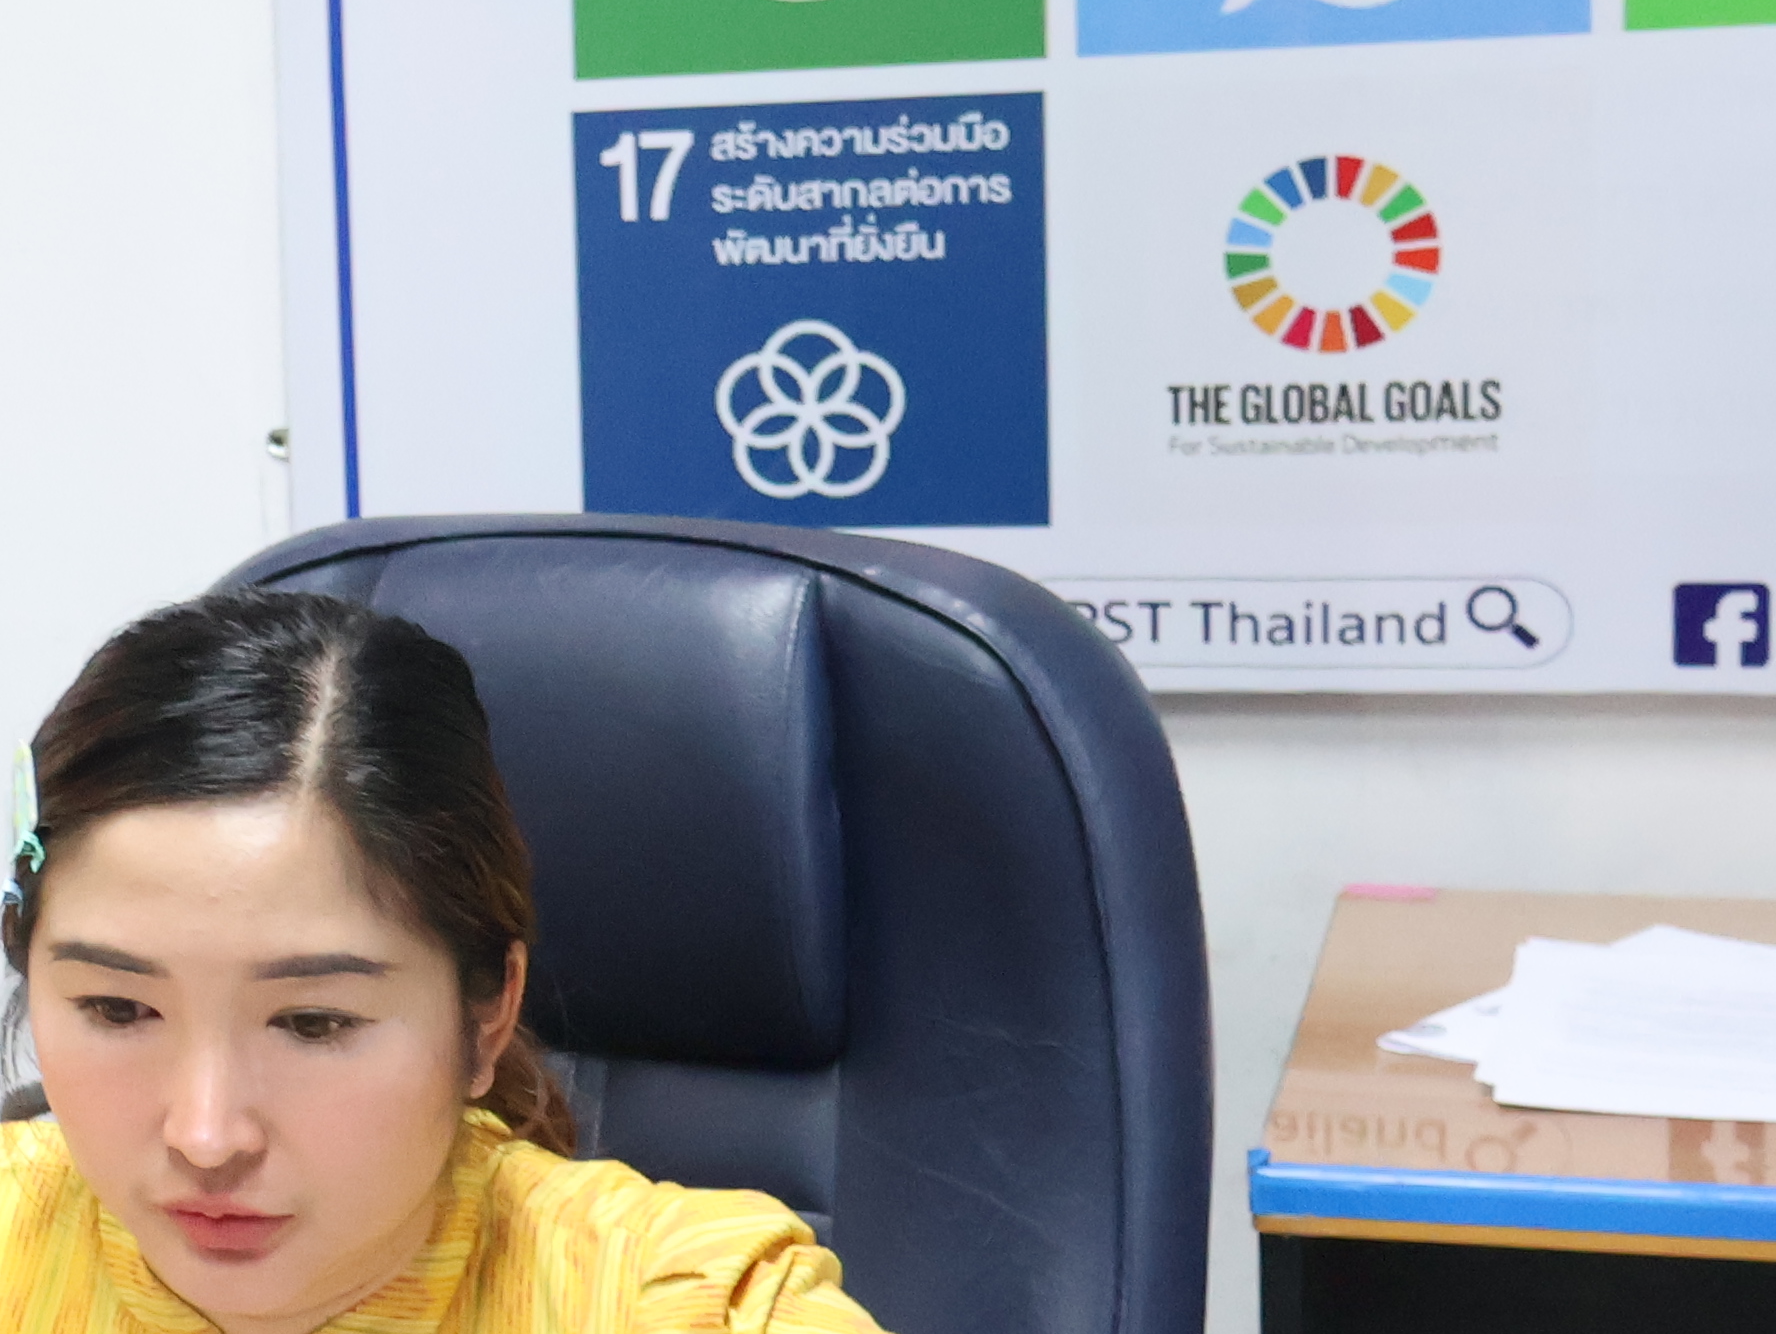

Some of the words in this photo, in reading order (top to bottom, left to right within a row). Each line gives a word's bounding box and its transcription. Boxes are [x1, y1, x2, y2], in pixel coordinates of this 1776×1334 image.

[710, 111, 1009, 161] สร้างความร่วมมือ
[599, 129, 695, 222] 17
[711, 168, 1012, 213] ระดับสากลต่อการ
[712, 214, 945, 265] พัฒนาที่ยั่งยืน
[1167, 384, 1231, 426] THE
[1240, 382, 1374, 425] GLOBAL
[1385, 379, 1502, 422] GOALS
[1190, 599, 1448, 646] Thailand
